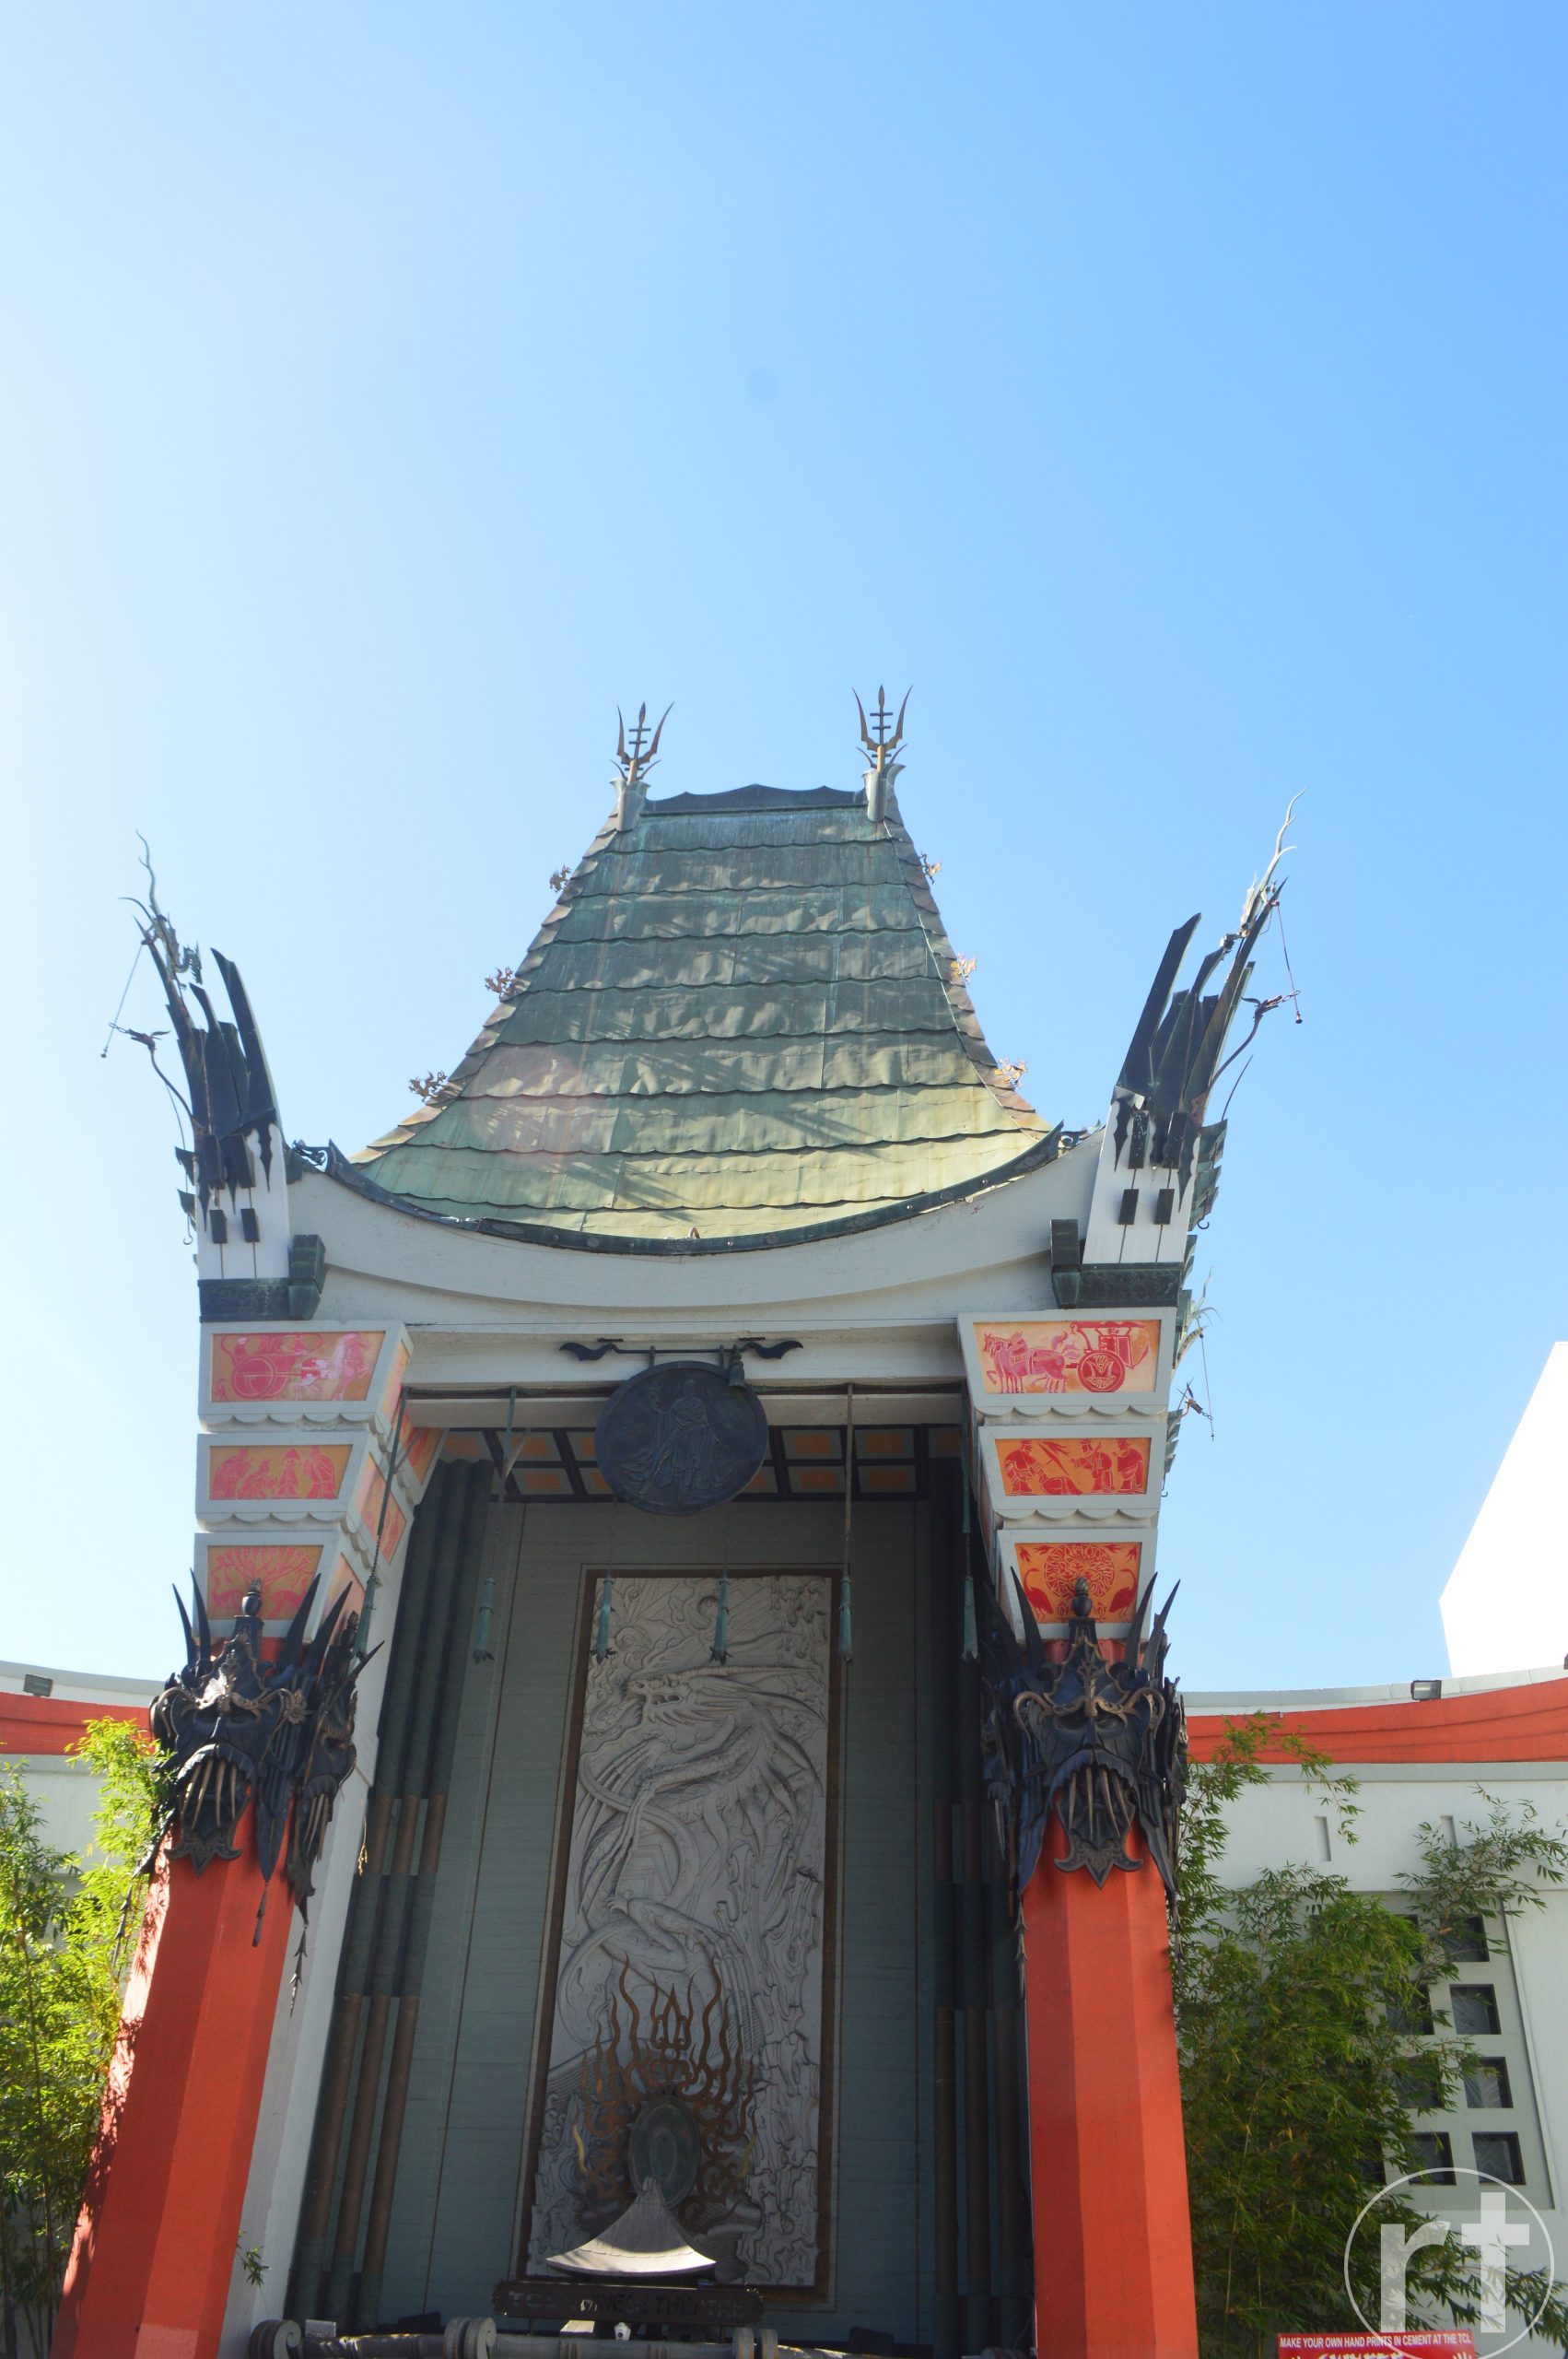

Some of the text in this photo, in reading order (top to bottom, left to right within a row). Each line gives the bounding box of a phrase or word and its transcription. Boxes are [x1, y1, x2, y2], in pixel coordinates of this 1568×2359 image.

[1279, 2332, 1471, 2349] MAKE YOUR OWN HAND PRINTS IN CEMENT AT THE TCL
